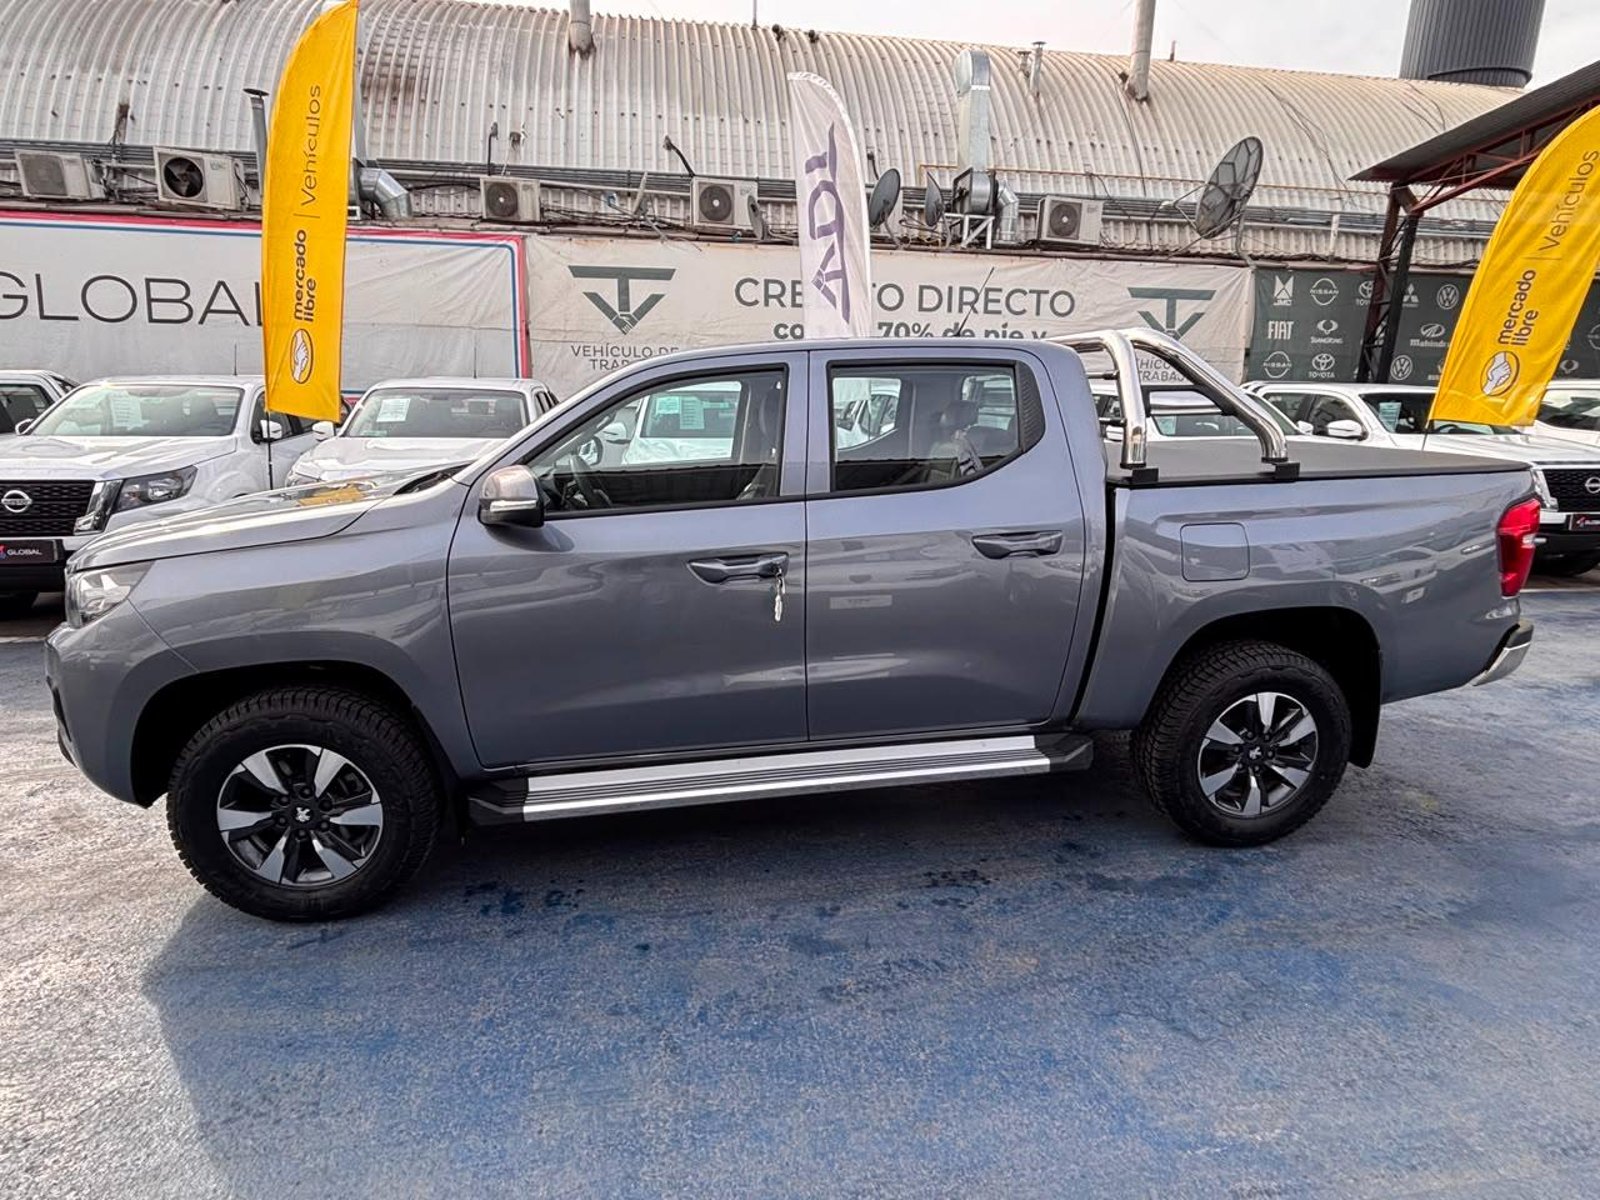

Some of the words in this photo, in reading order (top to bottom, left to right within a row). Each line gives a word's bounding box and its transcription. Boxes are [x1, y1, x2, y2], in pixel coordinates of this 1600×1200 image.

[301, 85, 321, 206] Vehículos
[1539, 150, 1600, 251] Vehículos
[294, 229, 307, 321] mercado
[304, 278, 317, 322] libre
[735, 278, 904, 311] CREO
[918, 285, 1076, 317] DIRECTO
[1497, 269, 1537, 345] mercado
[774, 323, 804, 340] co
[877, 322, 934, 338] 70%
[1268, 320, 1294, 339] FIAT
[1511, 309, 1539, 346] libre
[571, 342, 653, 359] VEHÍCULO
